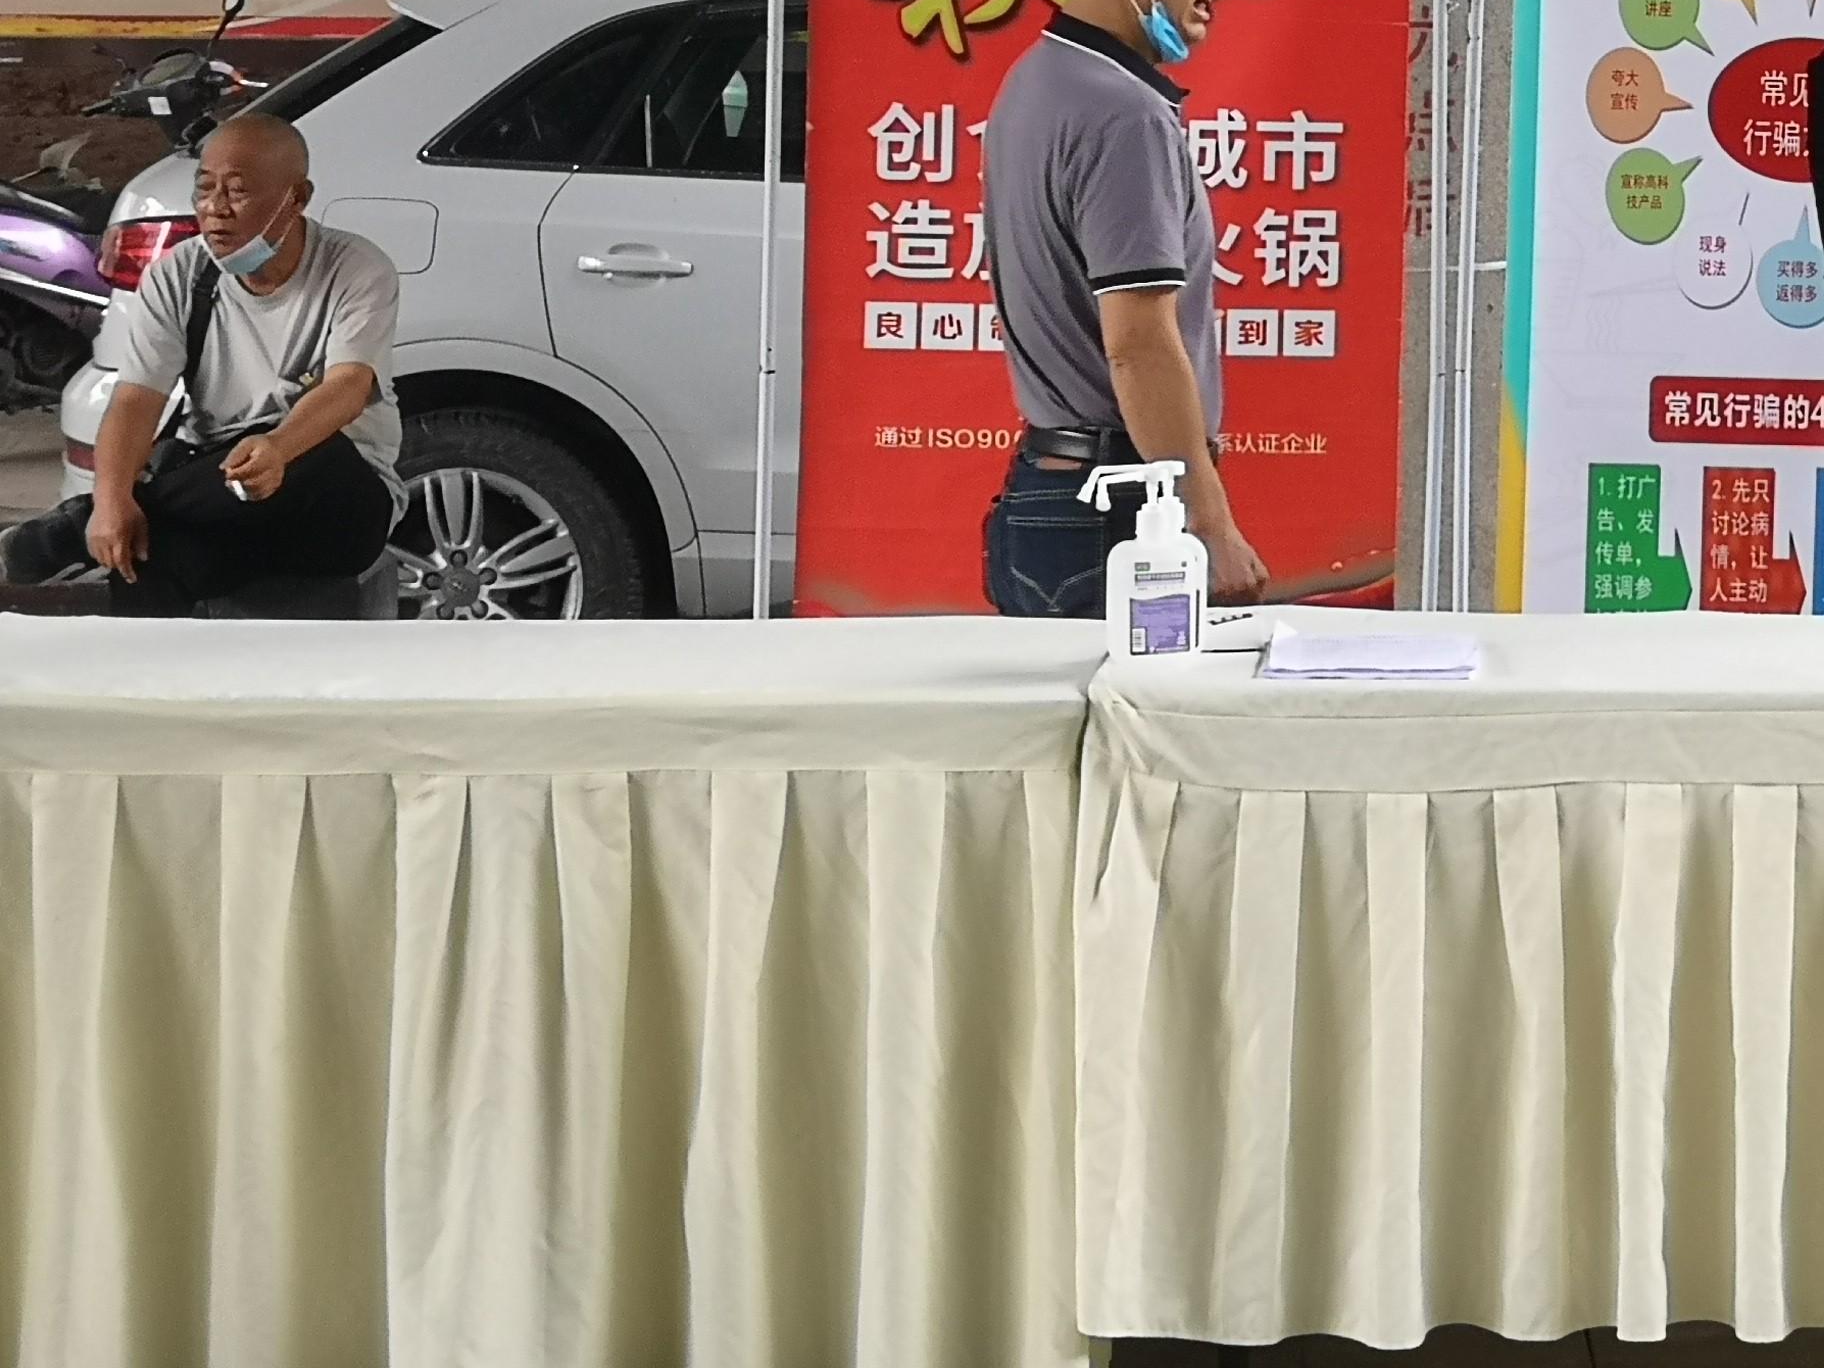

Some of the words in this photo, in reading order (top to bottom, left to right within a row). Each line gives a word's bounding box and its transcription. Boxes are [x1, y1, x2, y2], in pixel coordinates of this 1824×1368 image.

[1644, 0, 1673, 19] 讲座
[1610, 69, 1640, 89] 夸大
[1610, 92, 1640, 112] 宣传
[866, 100, 986, 184] 创
[1743, 119, 1810, 158] 行骗
[1620, 173, 1670, 191] 宣称高科
[1625, 194, 1664, 210] 技产品
[864, 198, 988, 282] 造
[1698, 235, 1728, 254] 现身
[1698, 259, 1728, 278] 说法
[1776, 260, 1819, 280] 买得多
[1775, 284, 1818, 304] 返得多
[1596, 509, 1654, 534] 告、发
[1710, 511, 1770, 537] 讨论病
[1710, 544, 1769, 570] 情，让
[1594, 574, 1653, 600] 强调参
[1709, 577, 1768, 602] 人主动
